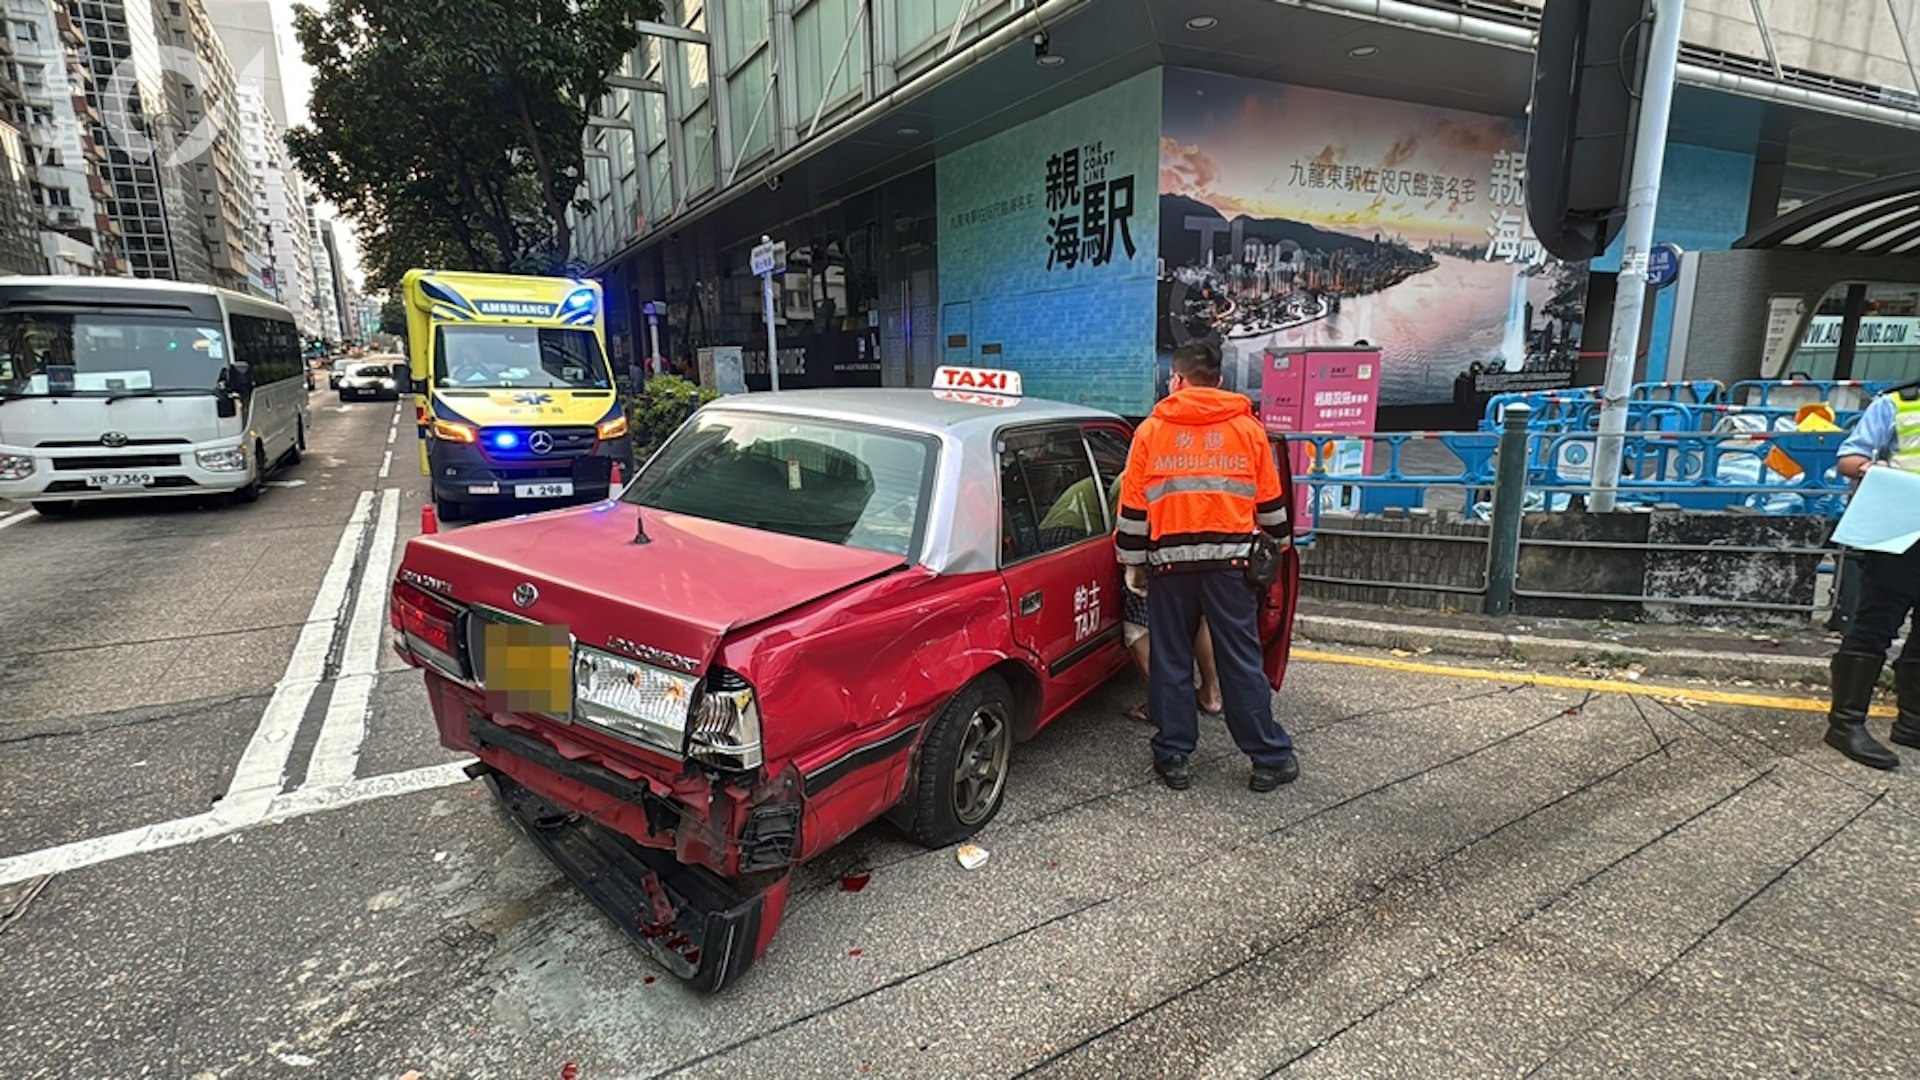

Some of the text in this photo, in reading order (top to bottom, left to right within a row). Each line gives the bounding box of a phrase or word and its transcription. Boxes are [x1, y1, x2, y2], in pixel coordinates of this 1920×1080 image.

[1083, 140, 1103, 158] THE
[1083, 150, 1115, 171] COAST
[1083, 167, 1106, 184] LINE
[481, 302, 551, 316] AMBULANCE
[943, 369, 1007, 390] TAXI
[1153, 454, 1248, 471] AMBULANCE
[1074, 580, 1101, 613] 的士
[1074, 606, 1100, 642] TAXI
